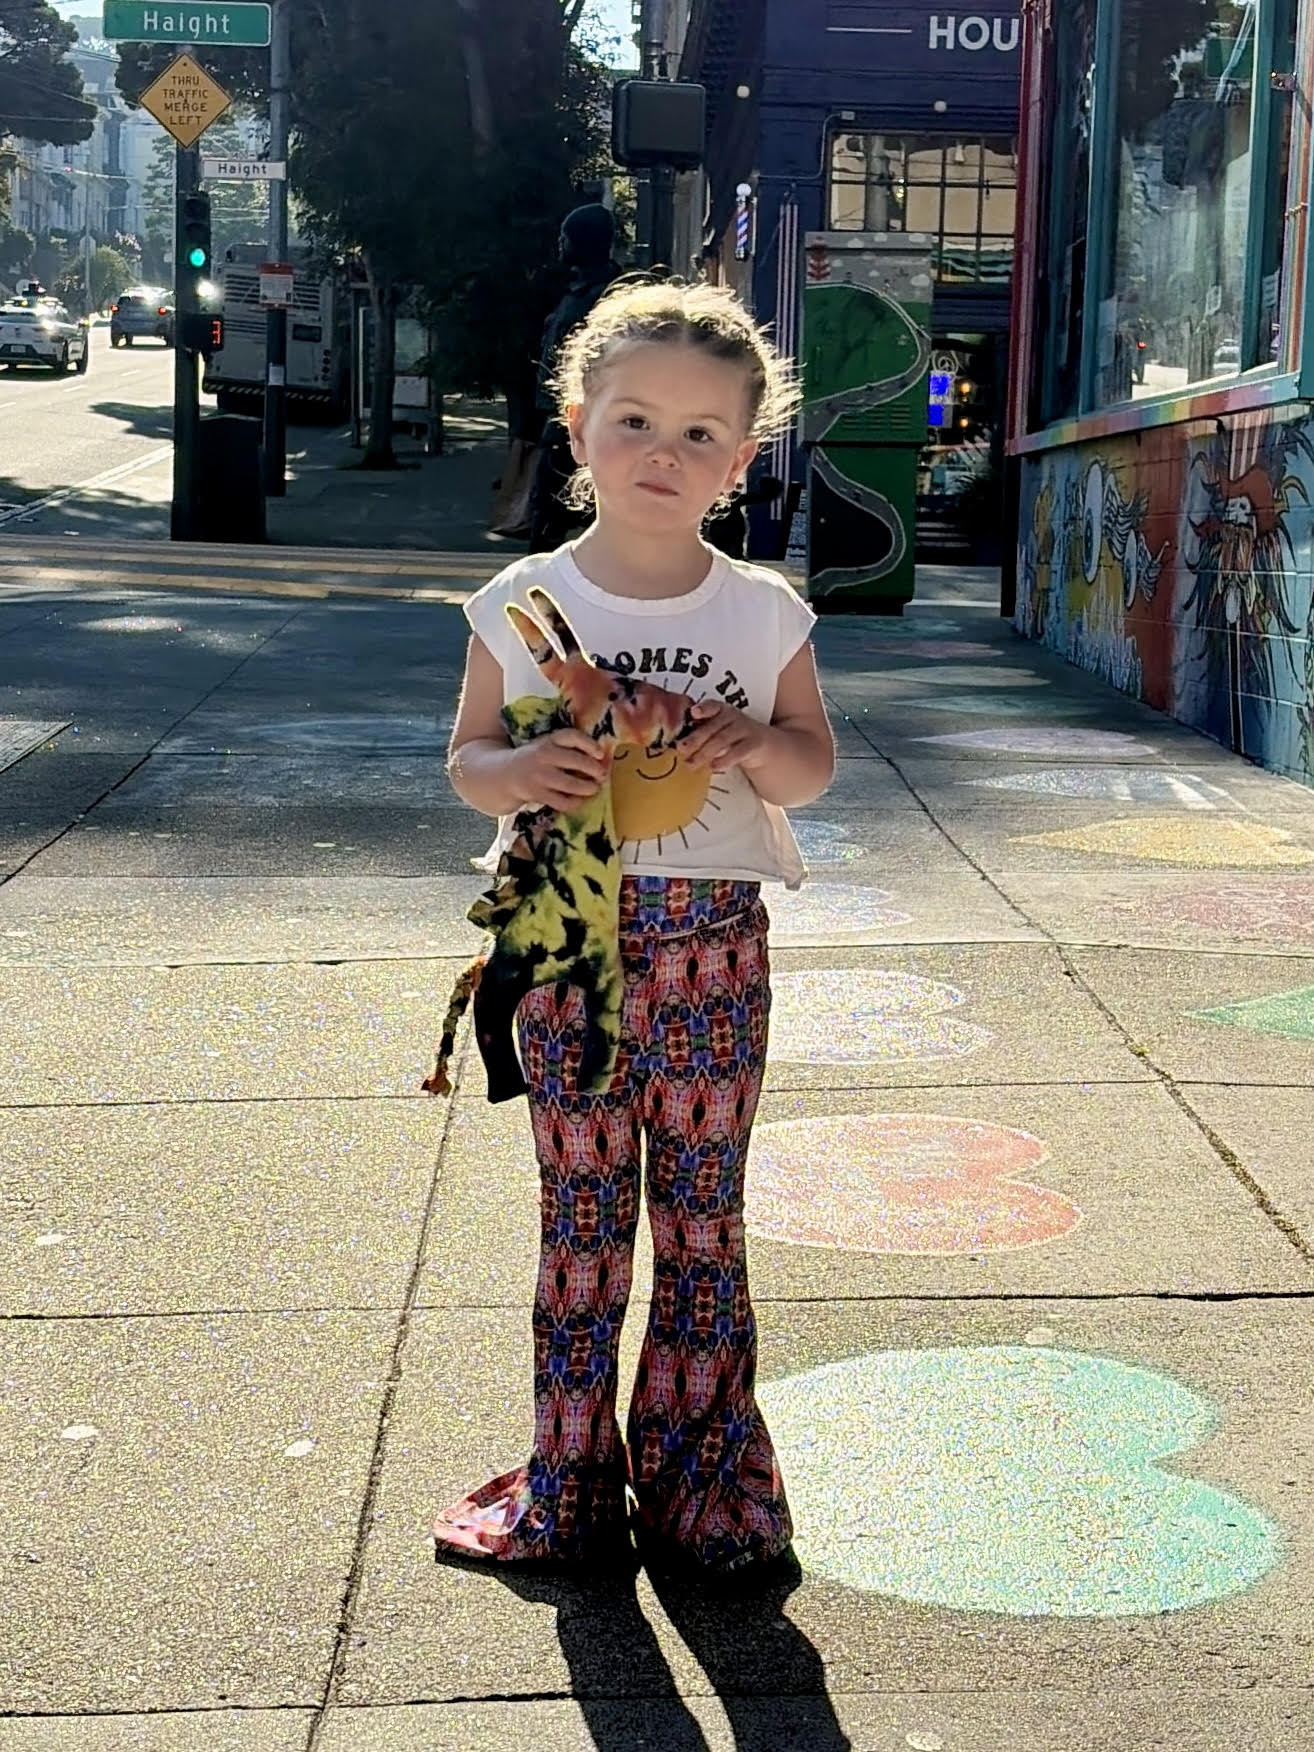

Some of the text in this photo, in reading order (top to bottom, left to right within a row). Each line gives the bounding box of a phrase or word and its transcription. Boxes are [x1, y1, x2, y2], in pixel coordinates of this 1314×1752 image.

[143, 10, 230, 39] Haight
[928, 15, 1020, 51] HOU
[171, 75, 200, 86] THRU
[162, 89, 209, 99] TRAFFIC
[164, 102, 208, 112] MERGE
[169, 115, 202, 125] LEFT
[217, 163, 267, 176] Haight
